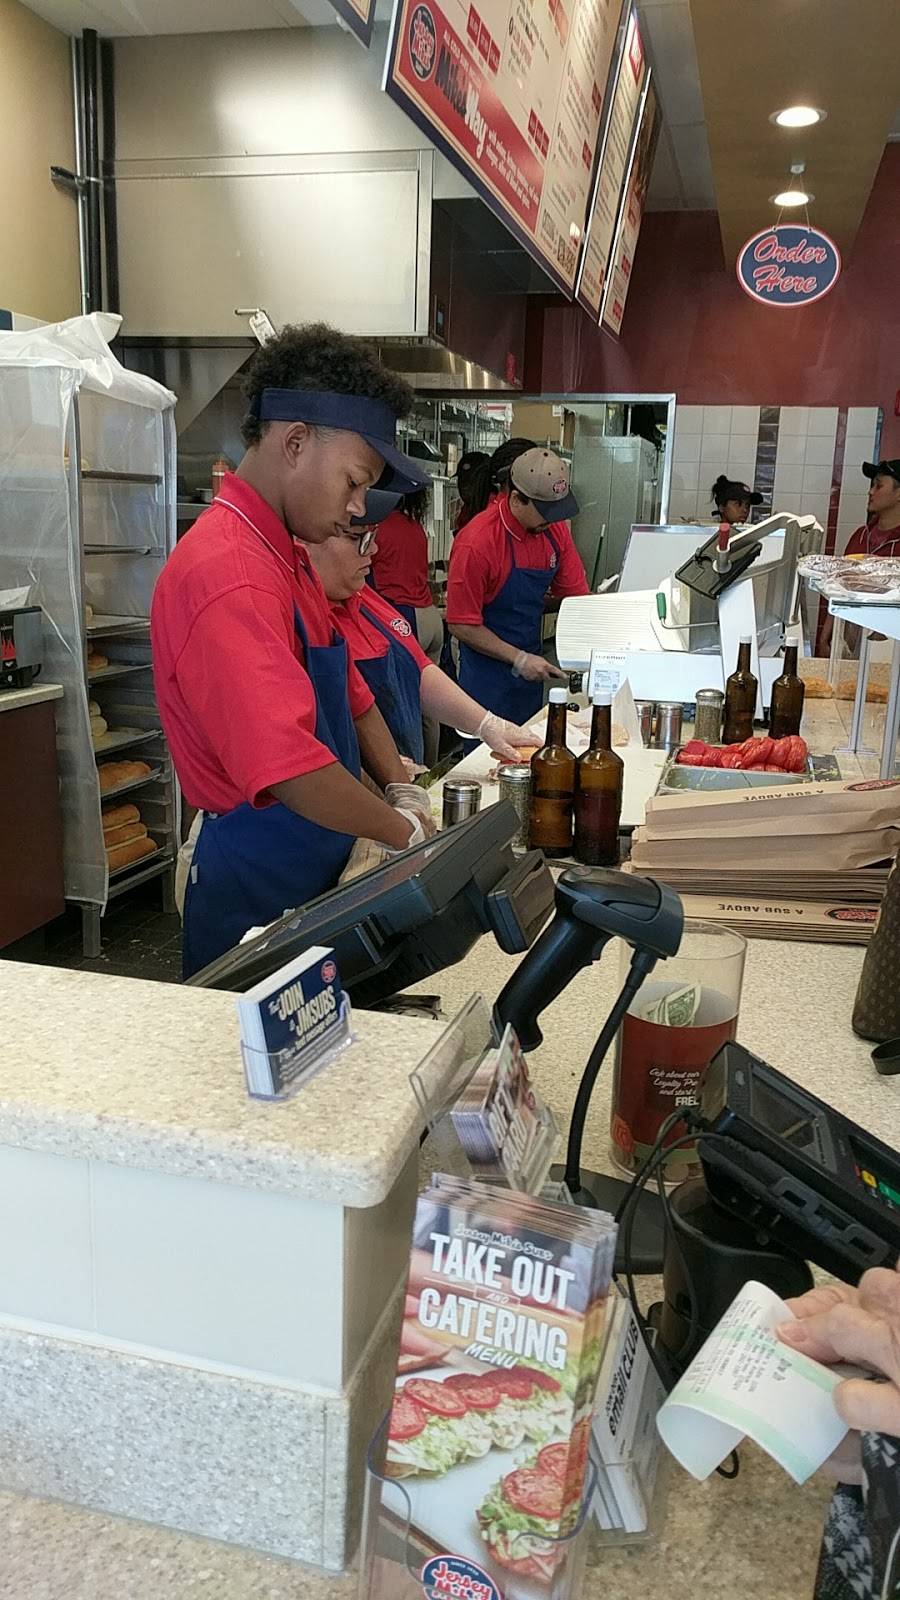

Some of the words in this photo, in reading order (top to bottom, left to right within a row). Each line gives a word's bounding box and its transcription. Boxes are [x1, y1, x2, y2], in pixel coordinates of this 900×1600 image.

[464, 81, 488, 160] Way
[754, 234, 827, 264] Order
[753, 264, 818, 293] Here
[718, 903, 760, 913] ABOVE
[764, 906, 791, 915] SUB
[279, 981, 305, 1020] JOIN
[296, 985, 336, 1036] JMSUBS
[653, 1077, 682, 1091] Loyalty
[665, 1070, 687, 1079] about
[658, 1088, 675, 1096] and
[455, 1223, 491, 1246] Jersey
[430, 1232, 506, 1290] TAKE
[511, 1255, 576, 1310] OUT
[486, 1291, 511, 1305] AND
[418, 1287, 568, 1370] CATERING
[464, 1342, 520, 1370] MENU
[431, 1561, 493, 1600] Jersey
